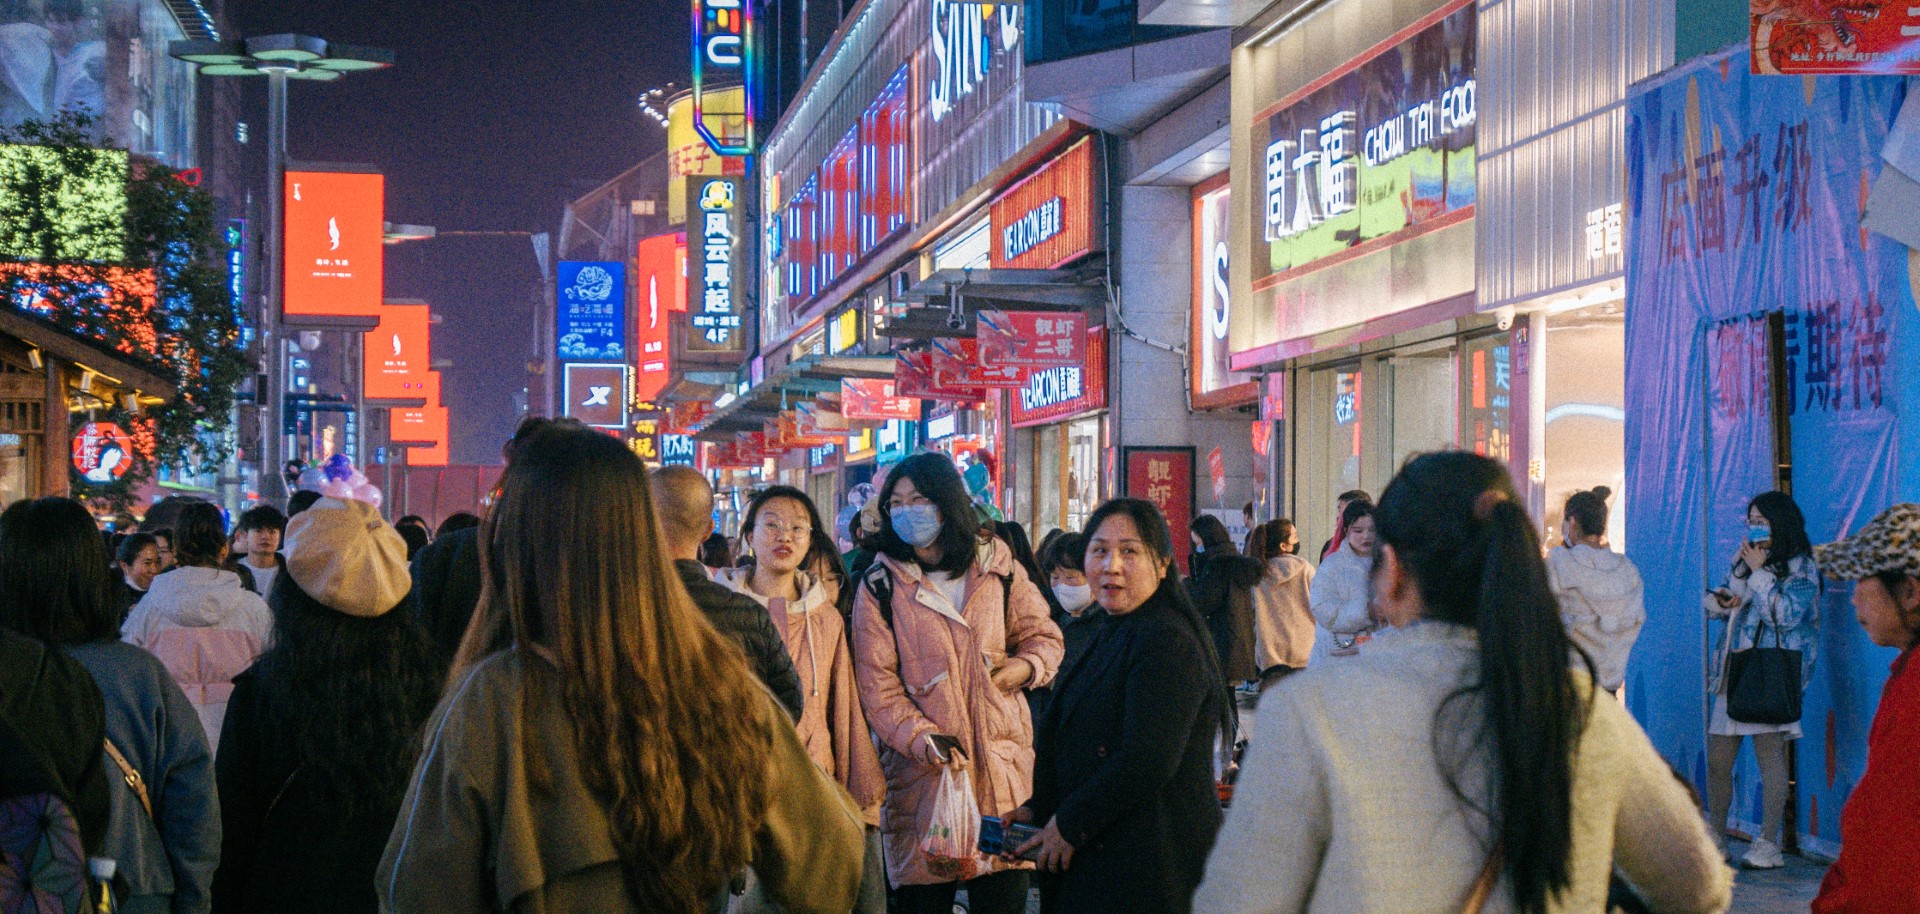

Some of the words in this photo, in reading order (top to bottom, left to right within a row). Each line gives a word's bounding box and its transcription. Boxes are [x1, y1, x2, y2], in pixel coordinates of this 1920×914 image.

[1365, 114, 1404, 167] CHOW
[1409, 99, 1433, 147] TAI
[1266, 110, 1357, 242] 周大福
[1661, 119, 1812, 266] 店面升级
[704, 212, 731, 314] 风云再起
[1003, 207, 1041, 262] YEARCON
[600, 327, 613, 337] F4
[705, 327, 729, 342] 4F
[1035, 338, 1075, 357] 二哥
[1021, 368, 1061, 411] YEARCON
[1148, 458, 1172, 527] 靓虾
